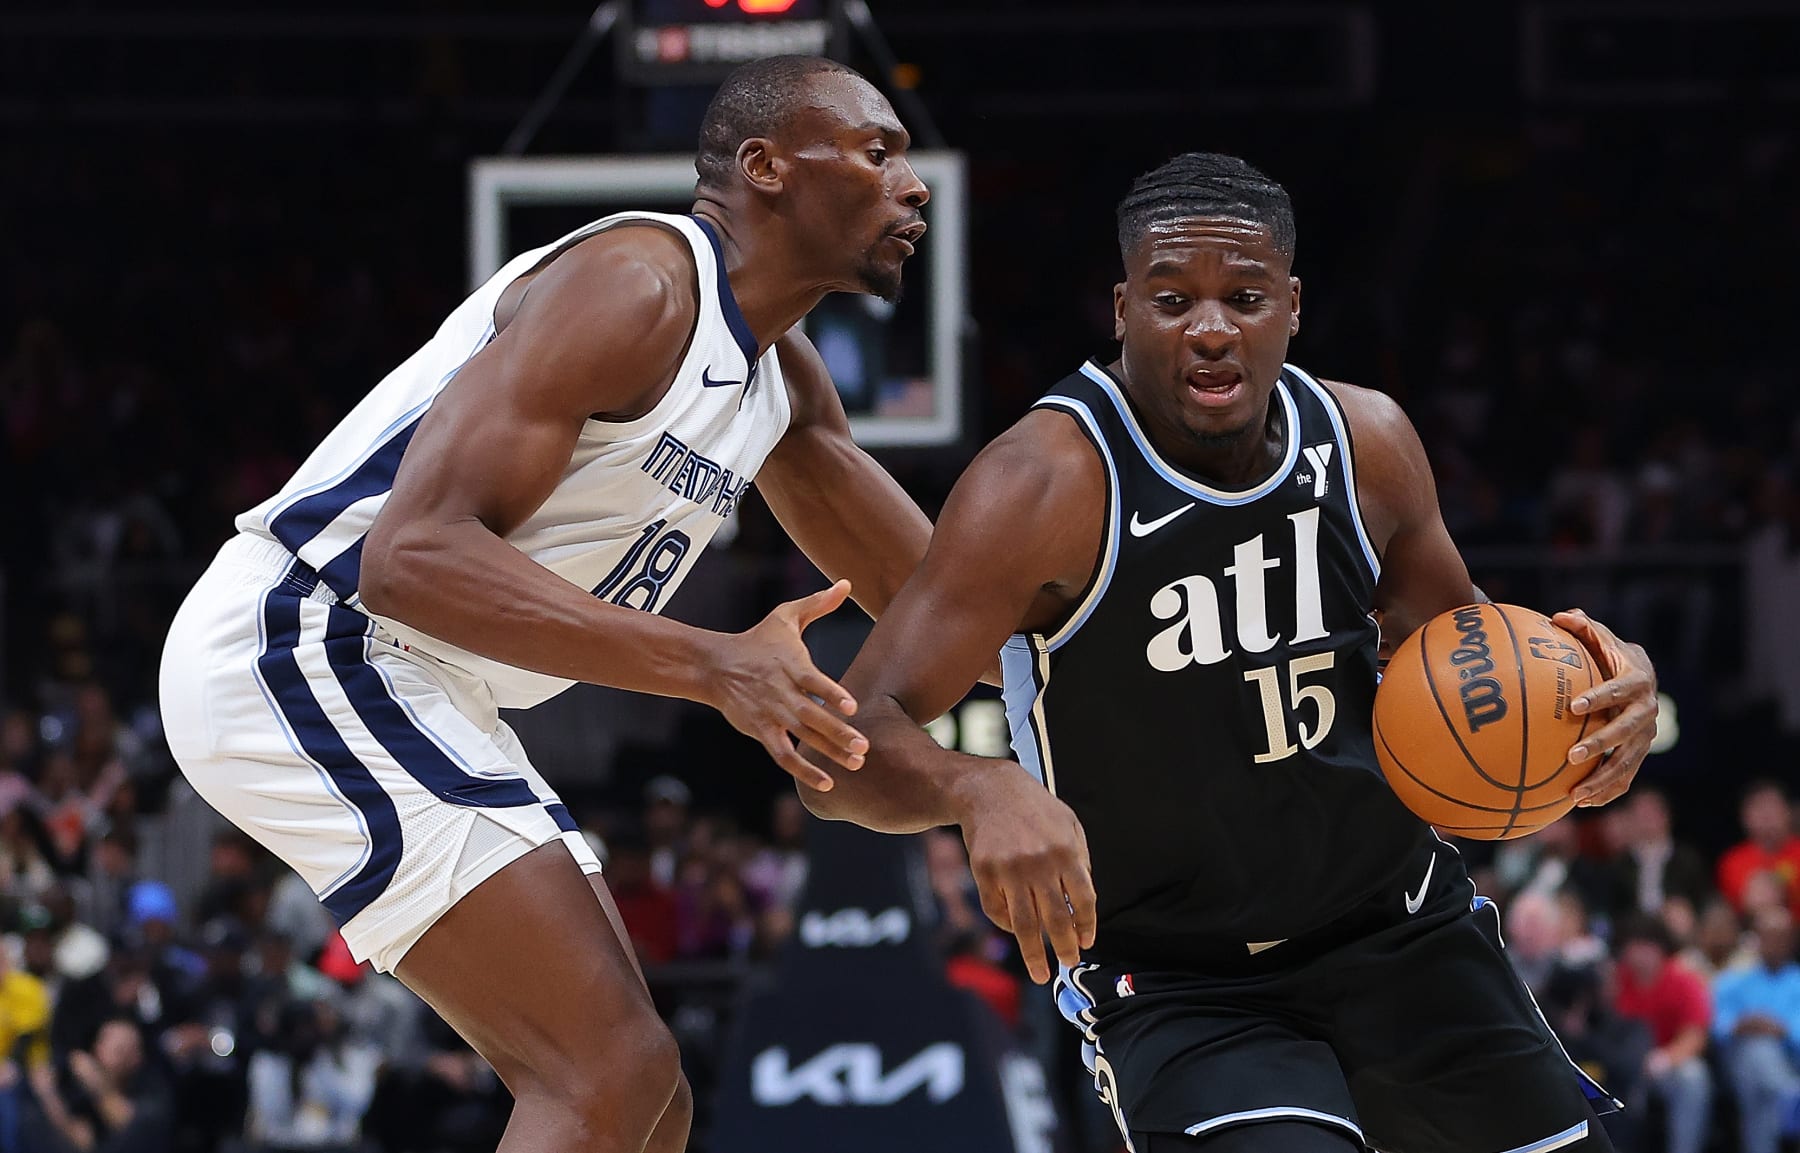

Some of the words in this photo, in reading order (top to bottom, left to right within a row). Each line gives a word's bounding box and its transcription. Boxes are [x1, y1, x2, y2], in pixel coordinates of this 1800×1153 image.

[641, 431, 750, 518] MEMPH
[1296, 473, 1312, 485] the
[1303, 443, 1333, 498] Y
[590, 519, 691, 612] 18
[1146, 506, 1331, 672] atl
[1244, 651, 1336, 763] 15
[1450, 605, 1508, 735] Wilson
